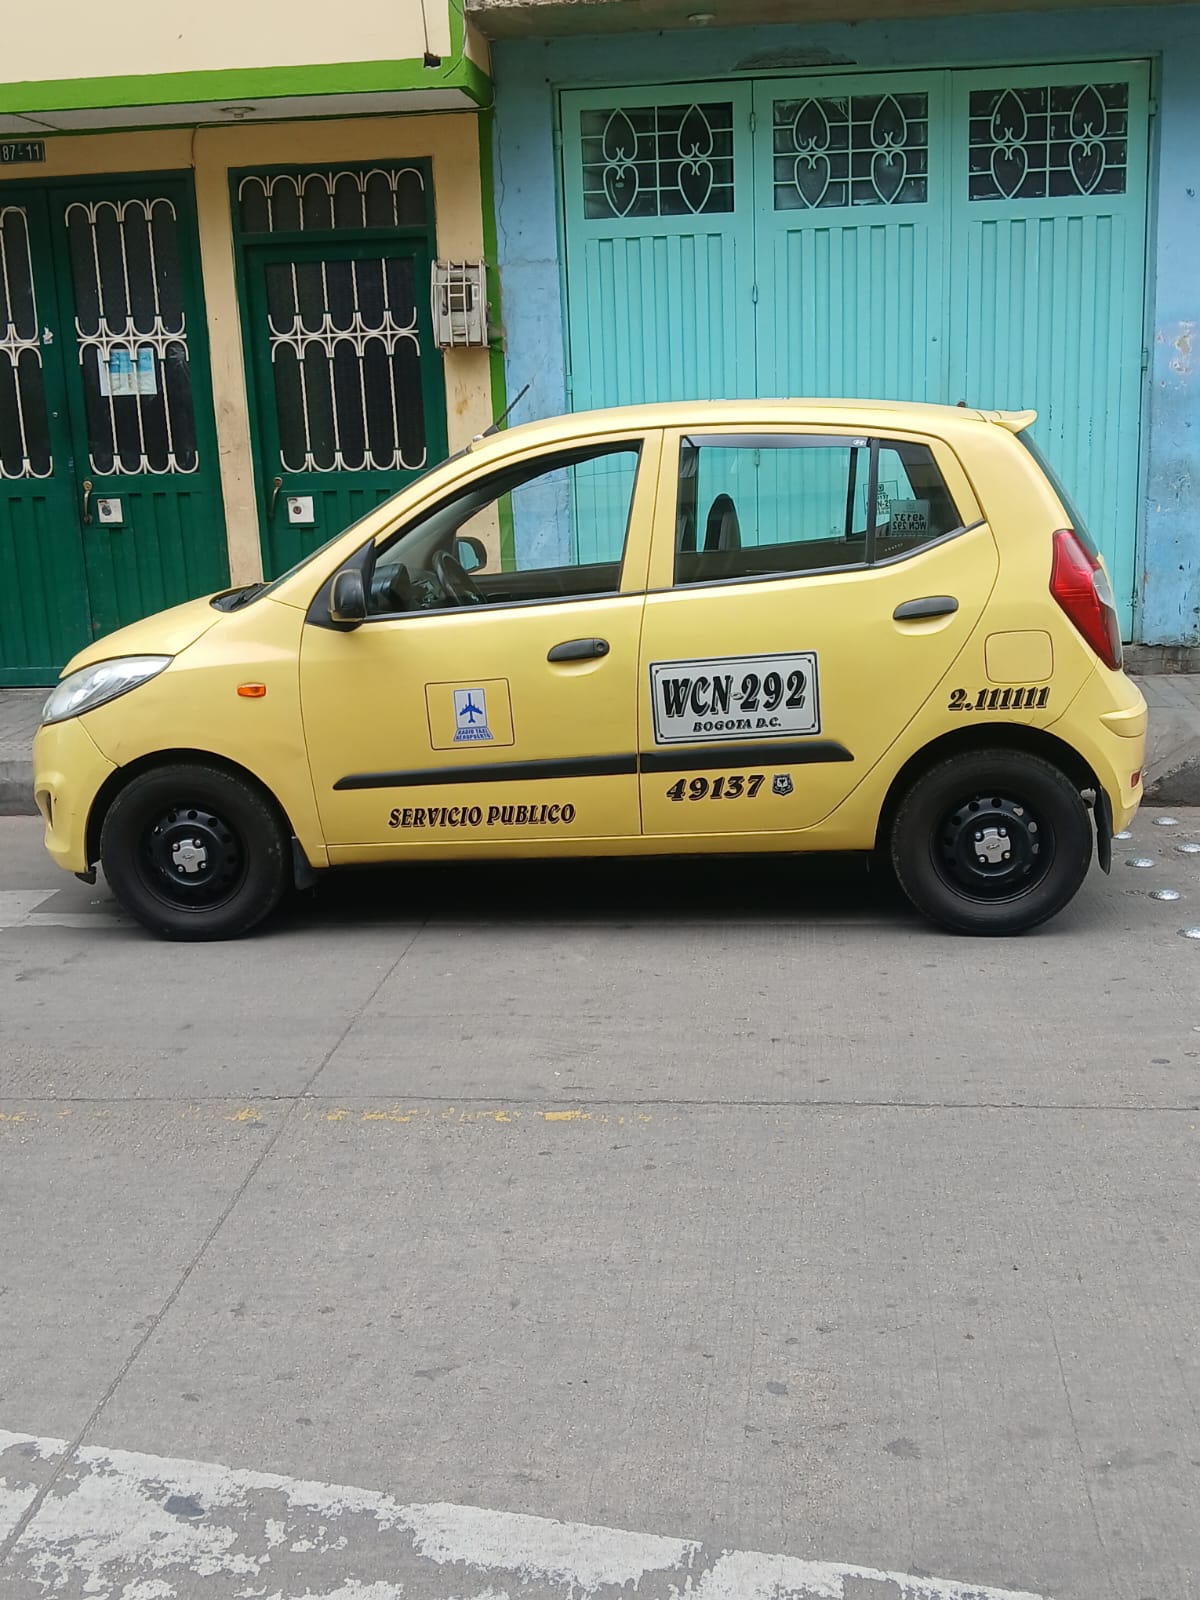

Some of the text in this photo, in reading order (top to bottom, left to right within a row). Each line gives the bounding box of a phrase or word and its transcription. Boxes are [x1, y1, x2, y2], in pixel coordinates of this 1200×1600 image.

[2, 143, 40, 161] 87-11
[661, 669, 807, 718] WCN-292
[948, 687, 1050, 711] 2.111111
[692, 716, 782, 733] BOGOTA D.C.
[666, 774, 765, 801] 49137
[388, 803, 576, 829] SERVICIO PUBLICO
